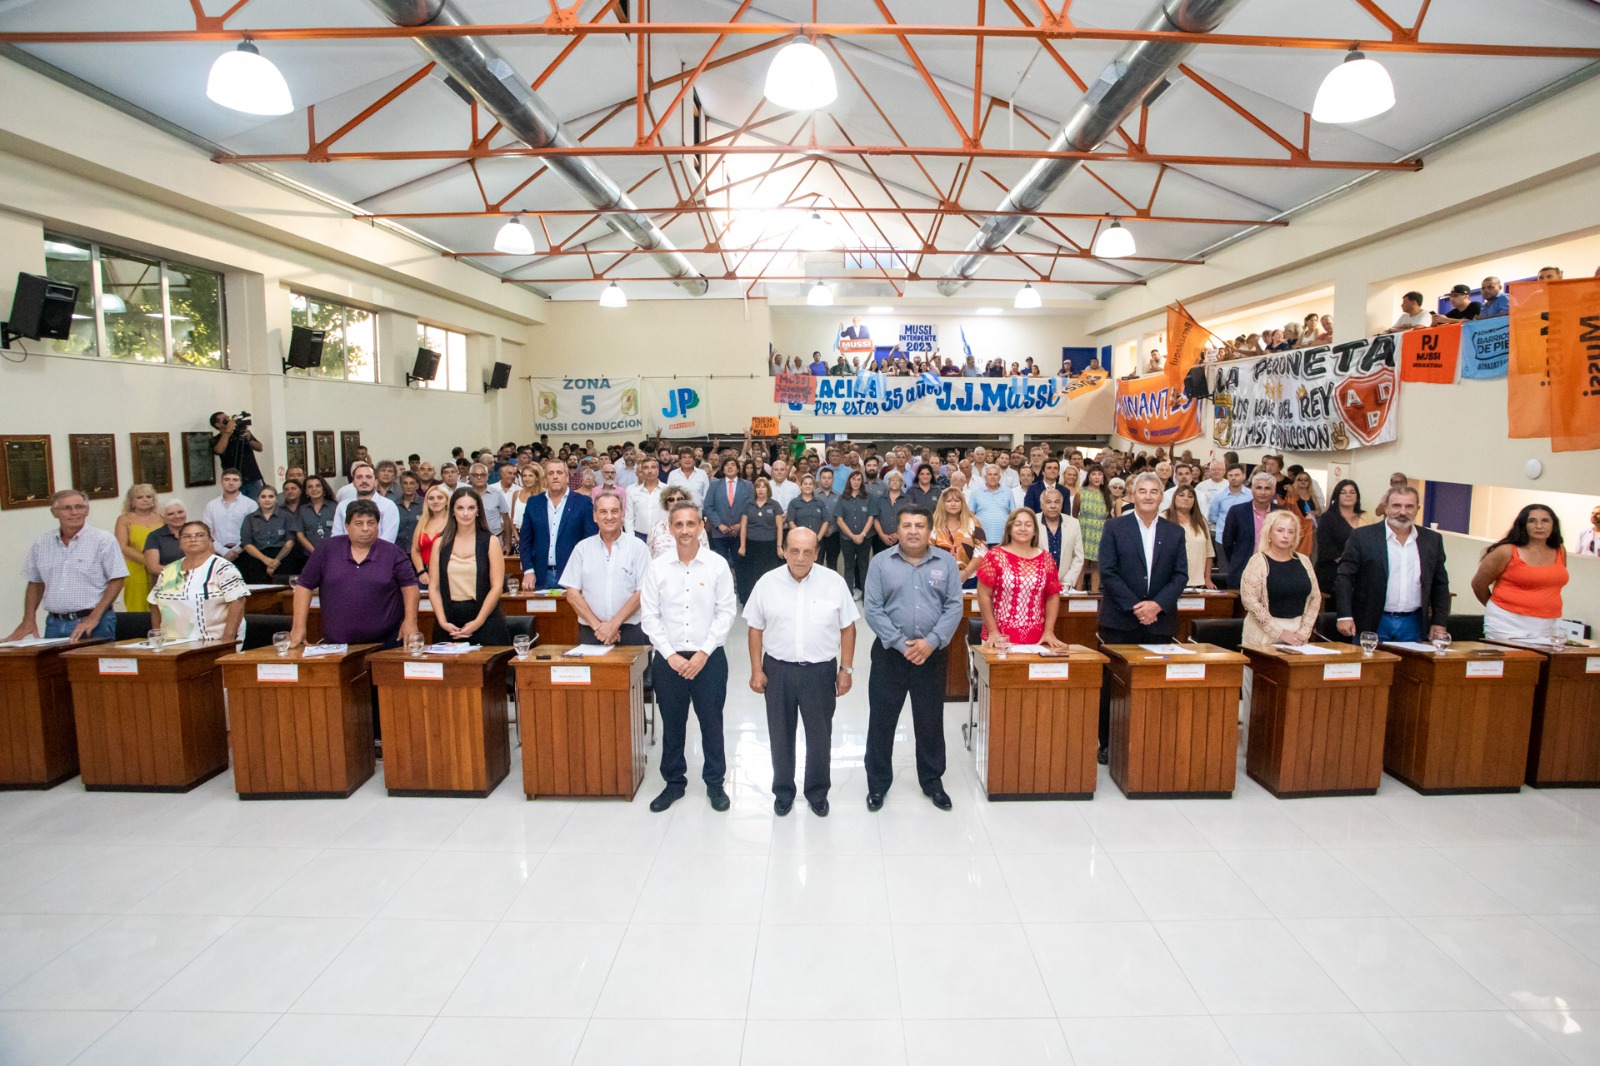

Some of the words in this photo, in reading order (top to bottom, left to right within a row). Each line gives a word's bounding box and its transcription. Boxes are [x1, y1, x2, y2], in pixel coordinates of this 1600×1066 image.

[905, 325, 932, 335] MUSSI
[906, 342, 932, 352] 2023
[1421, 334, 1439, 351] PJ
[1477, 344, 1492, 354] DE
[1216, 367, 1240, 393] LA
[1254, 335, 1396, 380] PERONETA
[563, 378, 611, 390] ZONA
[581, 395, 596, 415] 5
[842, 400, 879, 415] estos
[881, 387, 904, 411] 35
[1300, 382, 1334, 419] REY
[535, 422, 567, 432] MUSSI
[571, 419, 643, 431] CONDUCCION
